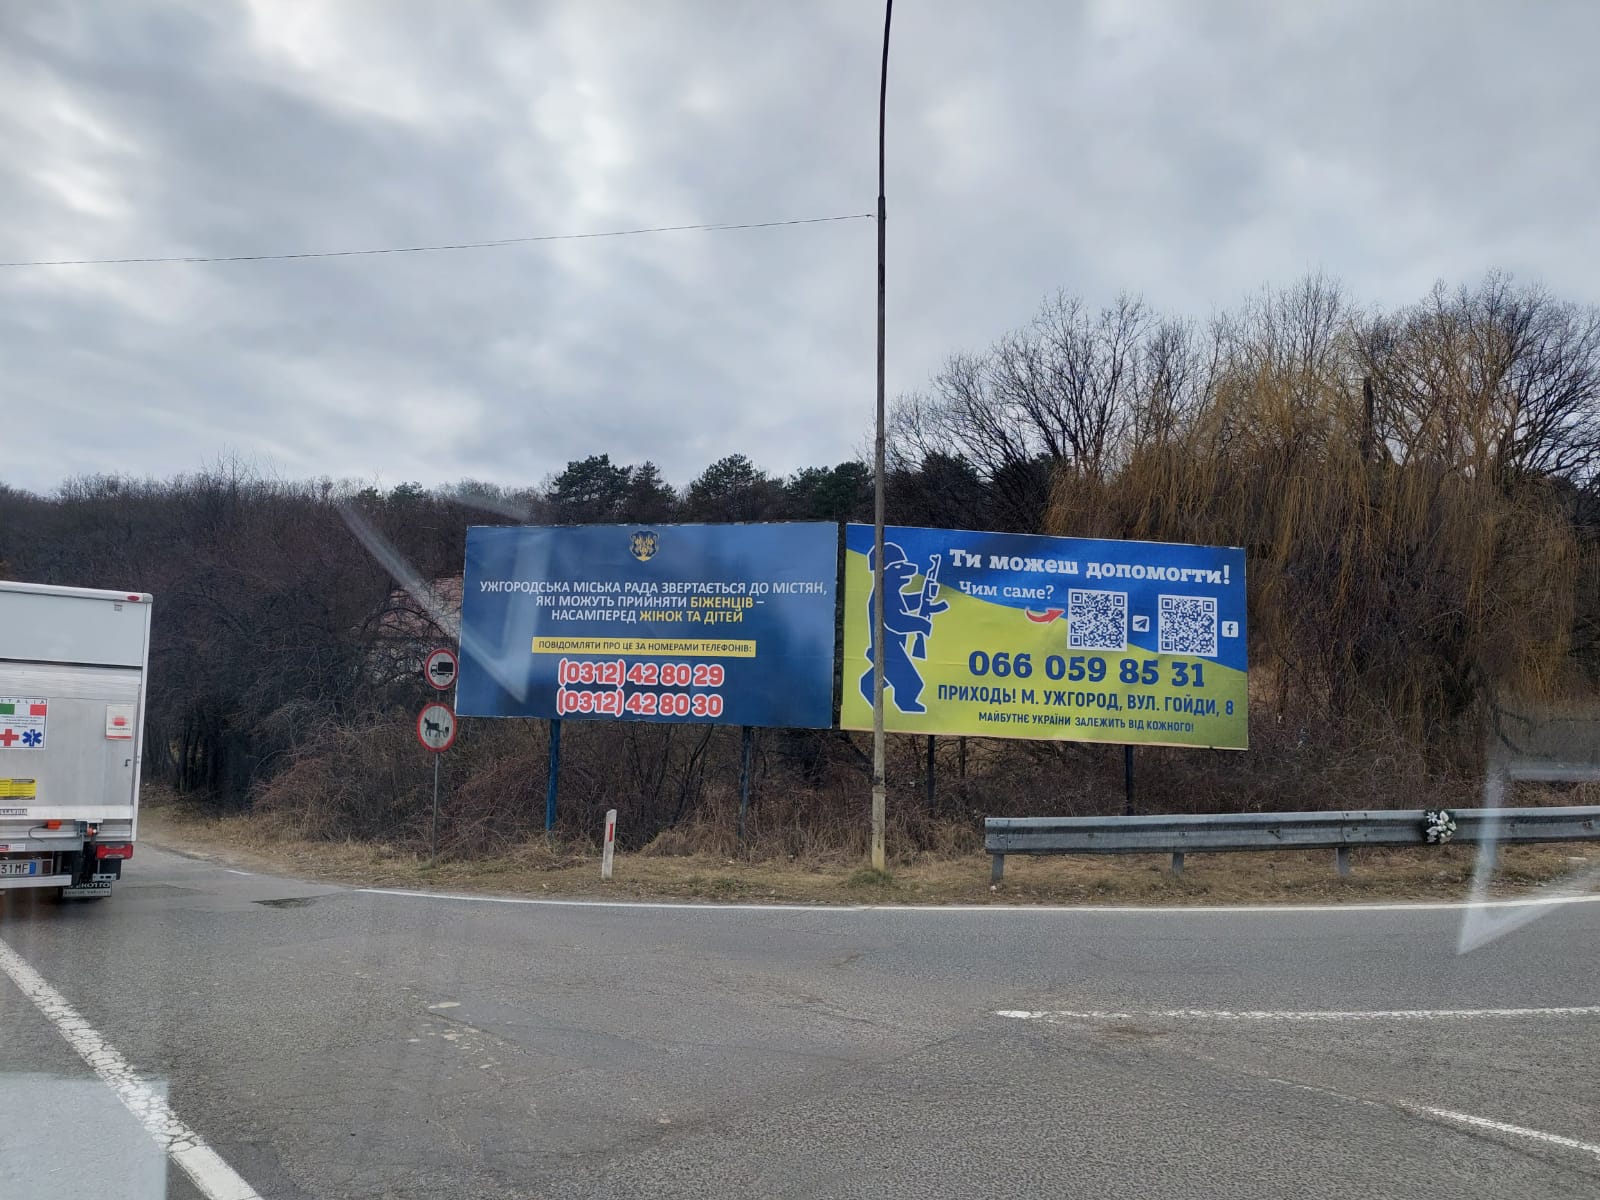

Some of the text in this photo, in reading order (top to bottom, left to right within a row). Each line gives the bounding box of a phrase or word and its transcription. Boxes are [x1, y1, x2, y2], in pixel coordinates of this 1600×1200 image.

[950, 549, 1231, 585] Ти можеш допомогти!
[480, 581, 828, 596] УЖГОРОДСЬКА МІСЬКА РАДА ЗВЕРТАЄТЬСЯ ДО МІСТЯН,
[959, 581, 1055, 600] Чим саме?
[535, 595, 556, 607] ЯКІ
[558, 596, 615, 607] МОЖУТЬ
[617, 594, 687, 608] ПРИЙНЯТИ
[690, 596, 754, 611] БІЖЕНЦІВ
[551, 609, 743, 625] НАСАМПЕРЕД ЖІНОК ТА ДІТЕЙ
[538, 640, 752, 653] ПОВІДОМЛЯТИ ПРО ЦЕ ЗА НОМЕРАМИ ТЕЛЕФОНІВ:
[558, 658, 725, 688] (0312) 42 80 29
[969, 651, 1204, 687] 066 059 85 31
[556, 688, 724, 717] (0312) 42 80 30
[938, 685, 1234, 717] ПРИХОДЬ! М. УЖГОРОД, ВУЛ. ГОЙДИ, 8
[978, 711, 1194, 732] МАЙБУТНЄ УКРАЇНИ ЗАЛЕЖИТЬ ВІД КОЖНОГО!
